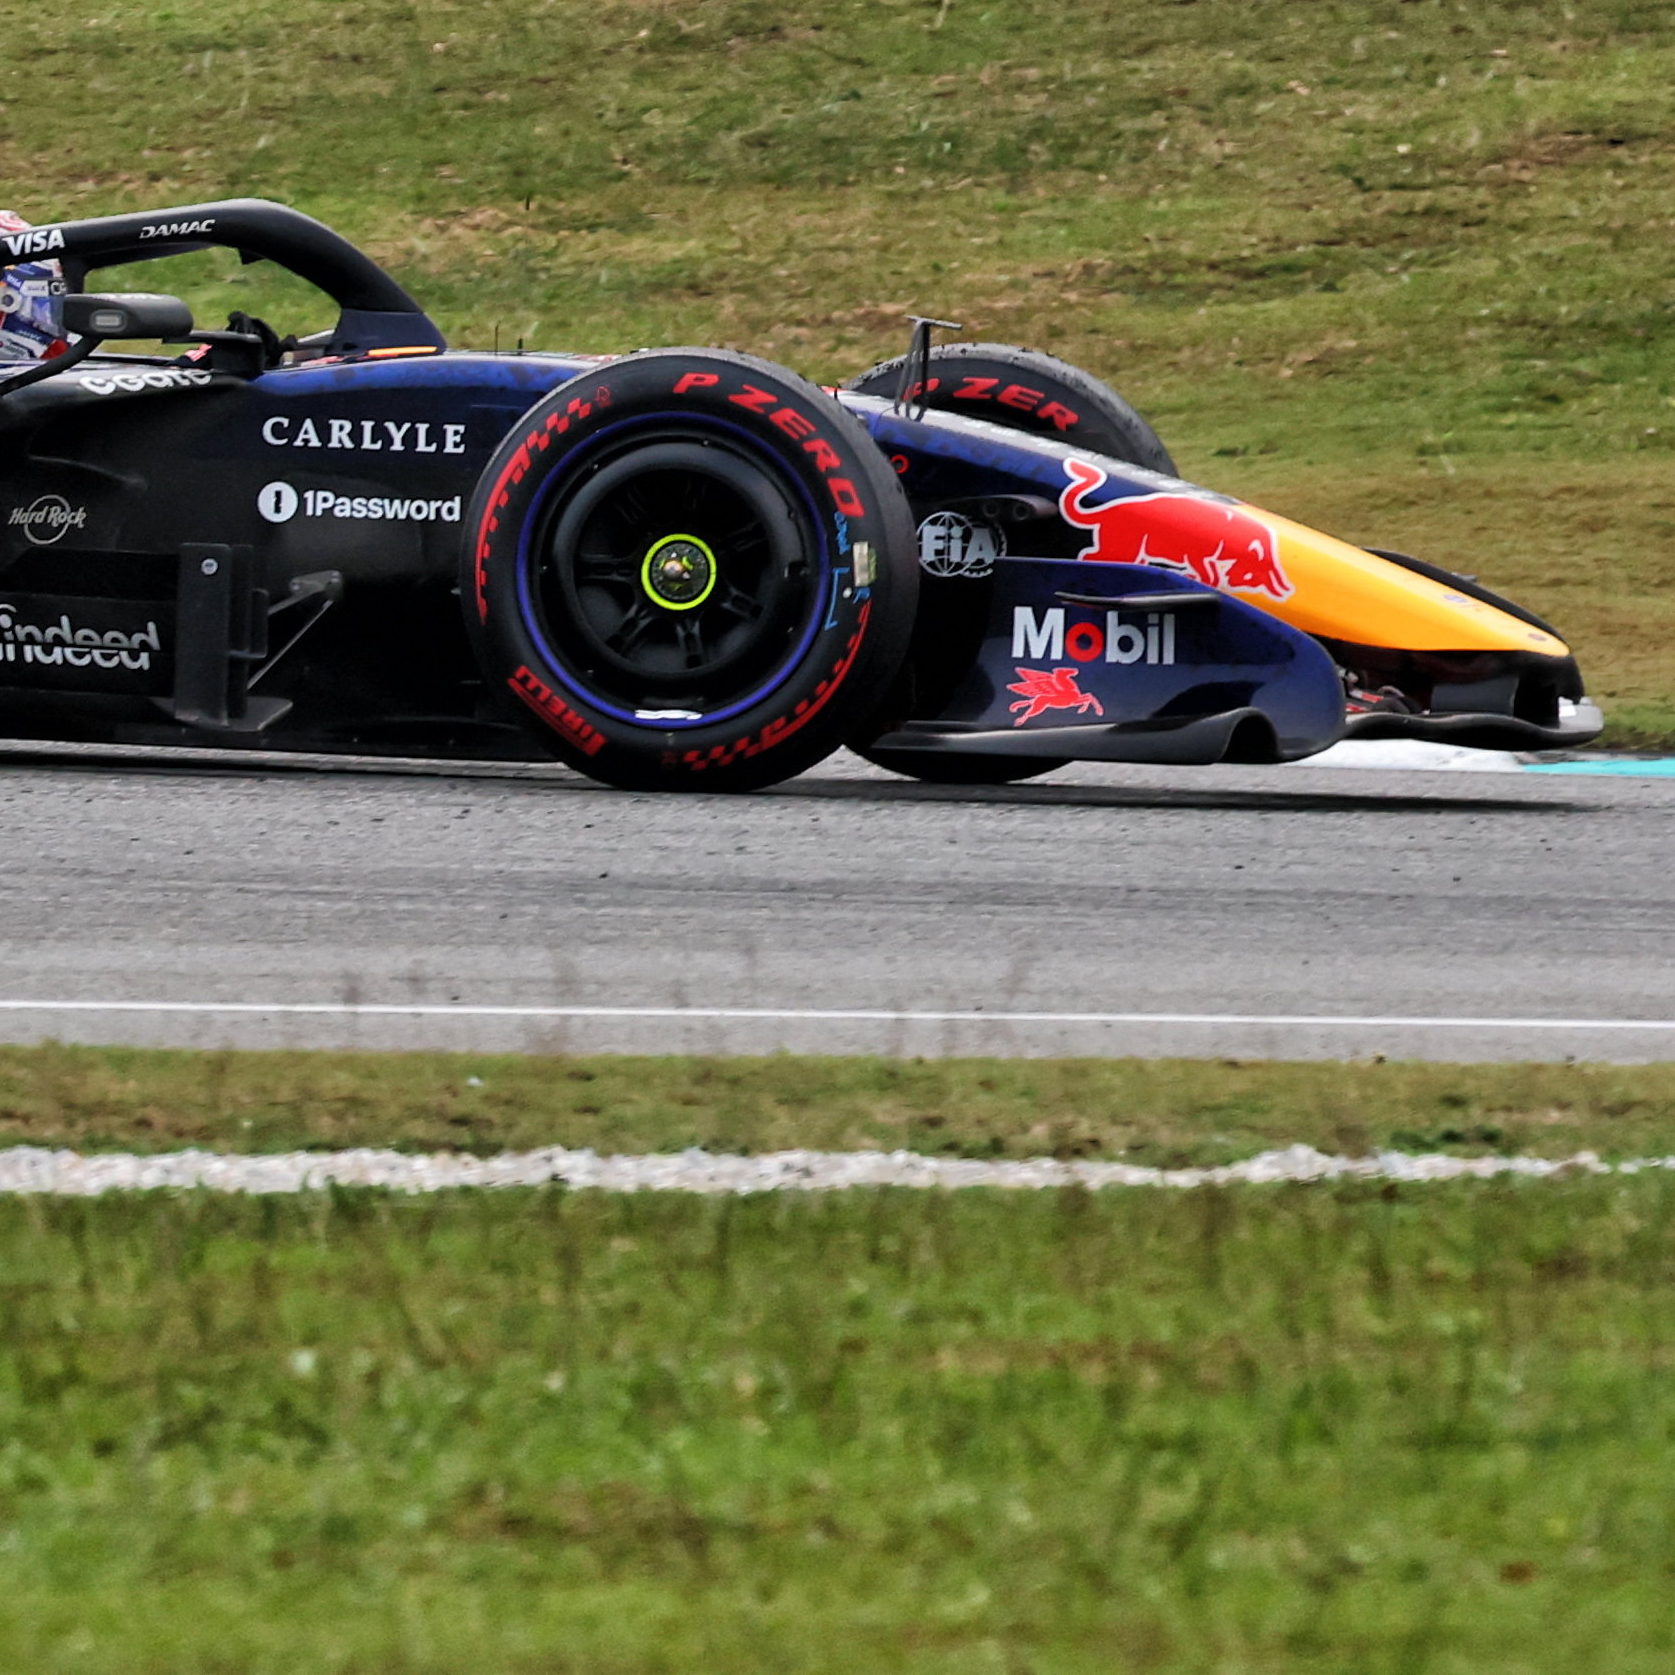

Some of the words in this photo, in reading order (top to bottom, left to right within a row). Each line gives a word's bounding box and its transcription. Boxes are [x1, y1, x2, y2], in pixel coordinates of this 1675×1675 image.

[2, 228, 66, 256] VISA
[139, 219, 216, 239] DAMAC
[952, 376, 1080, 432] ZER
[262, 416, 466, 454] CARLYLE
[673, 371, 721, 394] P
[727, 383, 866, 518] ZERO
[8, 505, 48, 524] Hard
[47, 505, 87, 529] Rock
[303, 489, 462, 522] 1Password
[1011, 605, 1176, 666] Mobil
